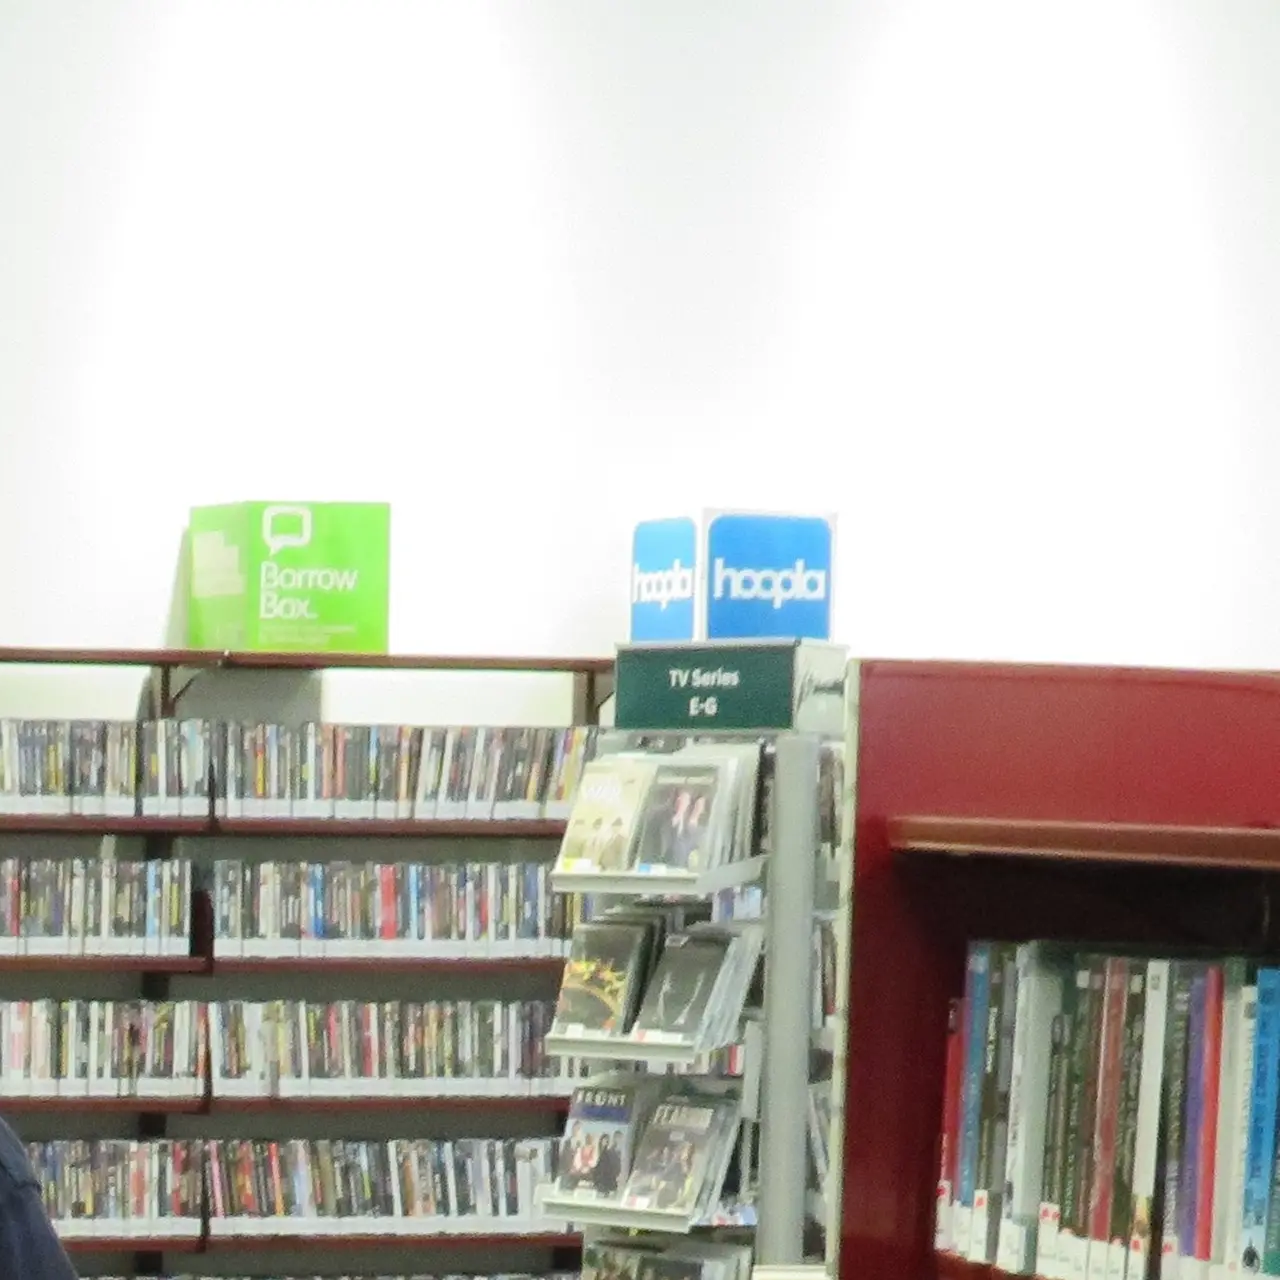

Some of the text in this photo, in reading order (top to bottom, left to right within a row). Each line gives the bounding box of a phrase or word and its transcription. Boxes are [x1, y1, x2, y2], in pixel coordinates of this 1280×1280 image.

[260, 560, 359, 591] Borrow
[713, 557, 827, 609] hoopla
[668, 667, 740, 688] TV Series
